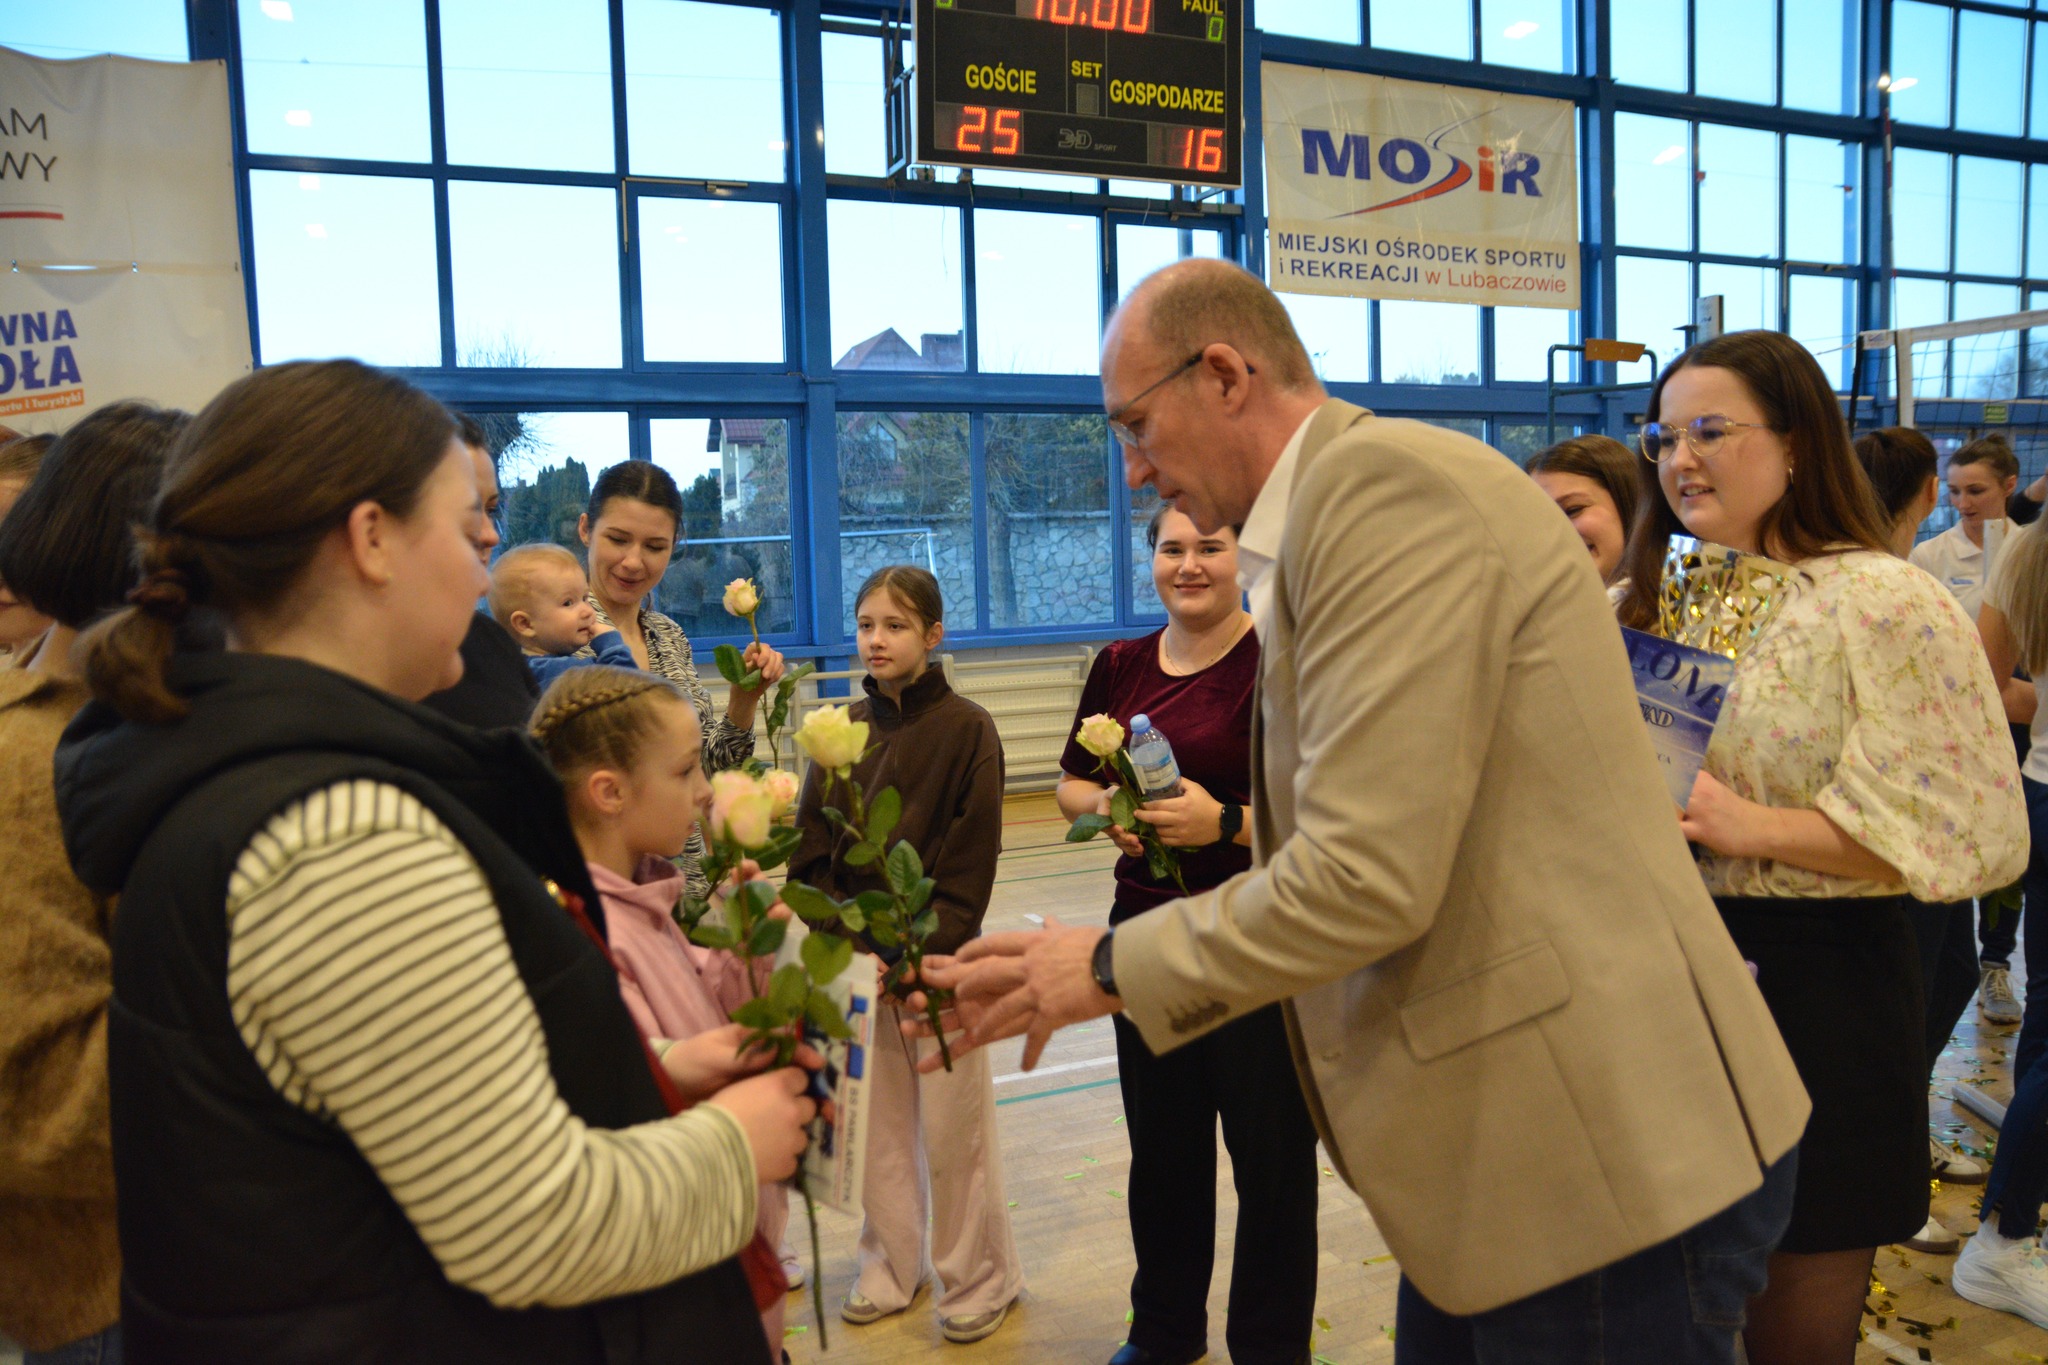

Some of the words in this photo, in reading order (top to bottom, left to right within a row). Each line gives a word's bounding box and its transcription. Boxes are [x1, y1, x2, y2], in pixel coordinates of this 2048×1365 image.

[1207, 16, 1225, 42] 0
[965, 62, 1037, 95] GOŚCIE
[1071, 60, 1103, 79] SET
[1109, 79, 1225, 114] GOSPODARZE
[957, 106, 1020, 155] 25
[1184, 128, 1223, 172] 16
[1278, 233, 1368, 256] MIEJSKI
[1376, 237, 1479, 264] OŚRODEK
[1485, 249, 1566, 269] SPORTU
[1278, 257, 1285, 275] i
[1290, 258, 1419, 284] REKREACJI
[1425, 270, 1441, 285] w
[1448, 268, 1567, 293] Lubaczowie
[32, 391, 81, 408] Turystyki
